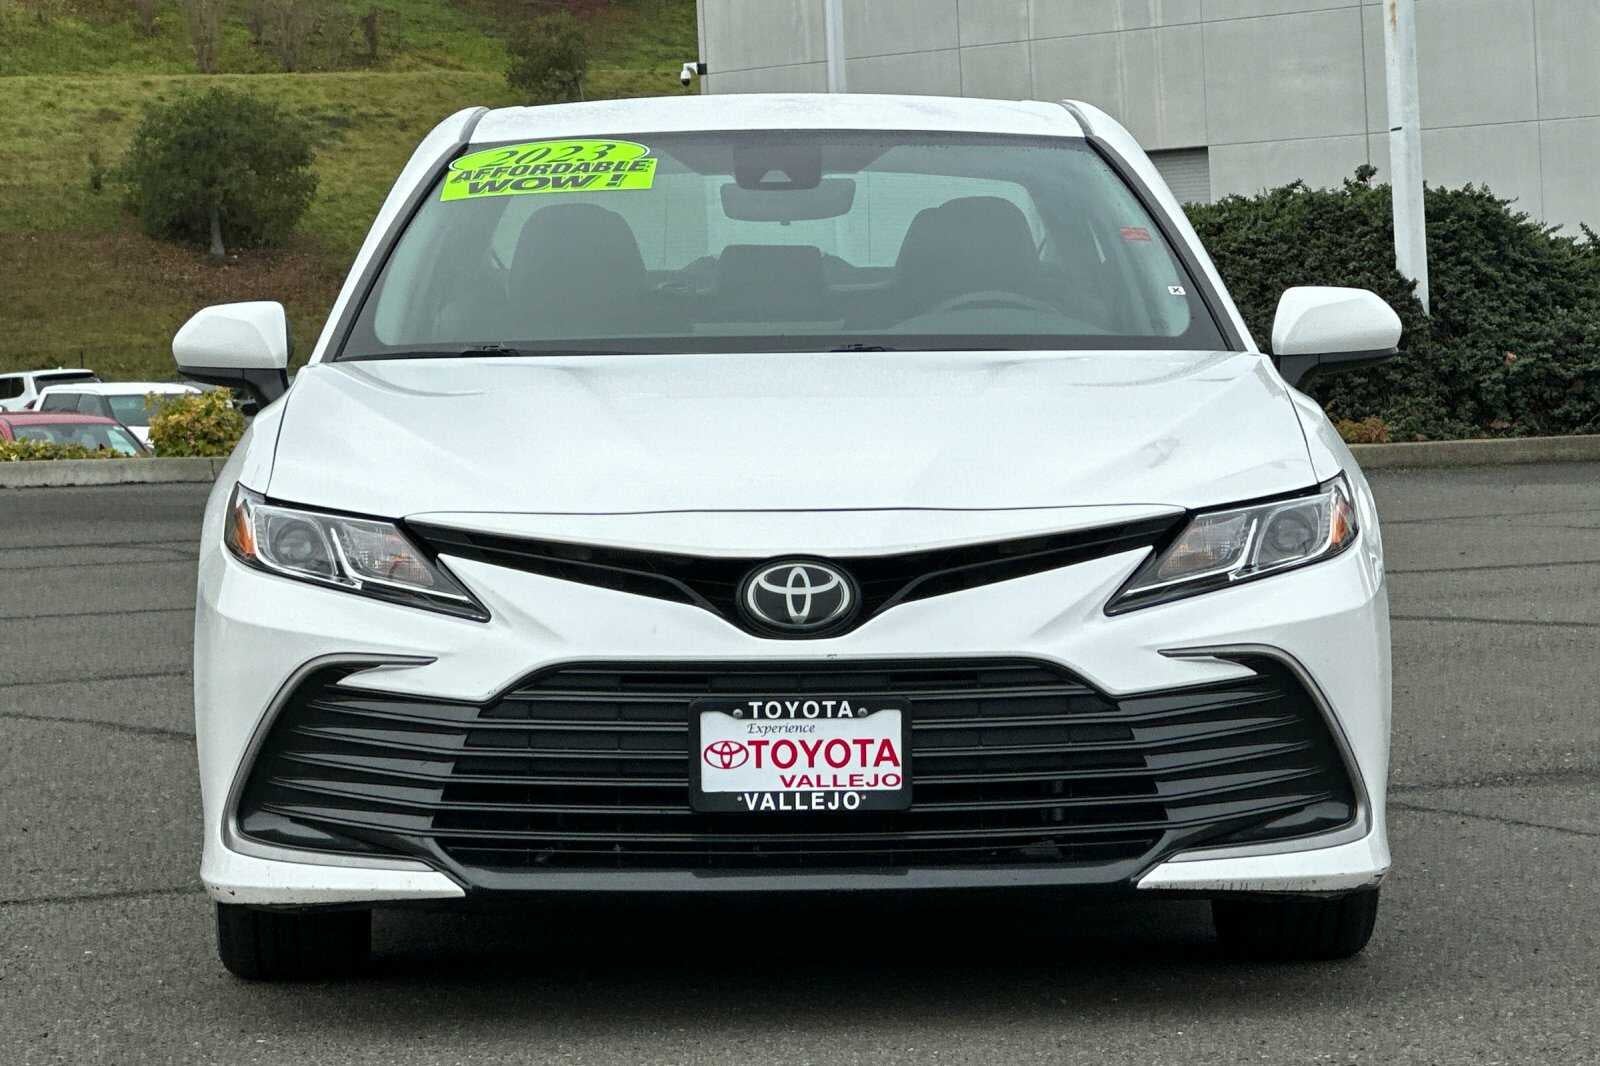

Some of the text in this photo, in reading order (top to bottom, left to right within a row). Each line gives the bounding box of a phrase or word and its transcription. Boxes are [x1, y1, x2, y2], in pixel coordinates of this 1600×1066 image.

[480, 143, 616, 167] 2023
[451, 159, 653, 183] AFFORDABLE
[468, 175, 597, 195] WOW
[748, 701, 853, 719] TOYOTA
[747, 723, 815, 737] Experience
[748, 738, 900, 769] TOYOTA
[779, 773, 901, 788] VALLEJO
[744, 792, 860, 810] VALLEJO
